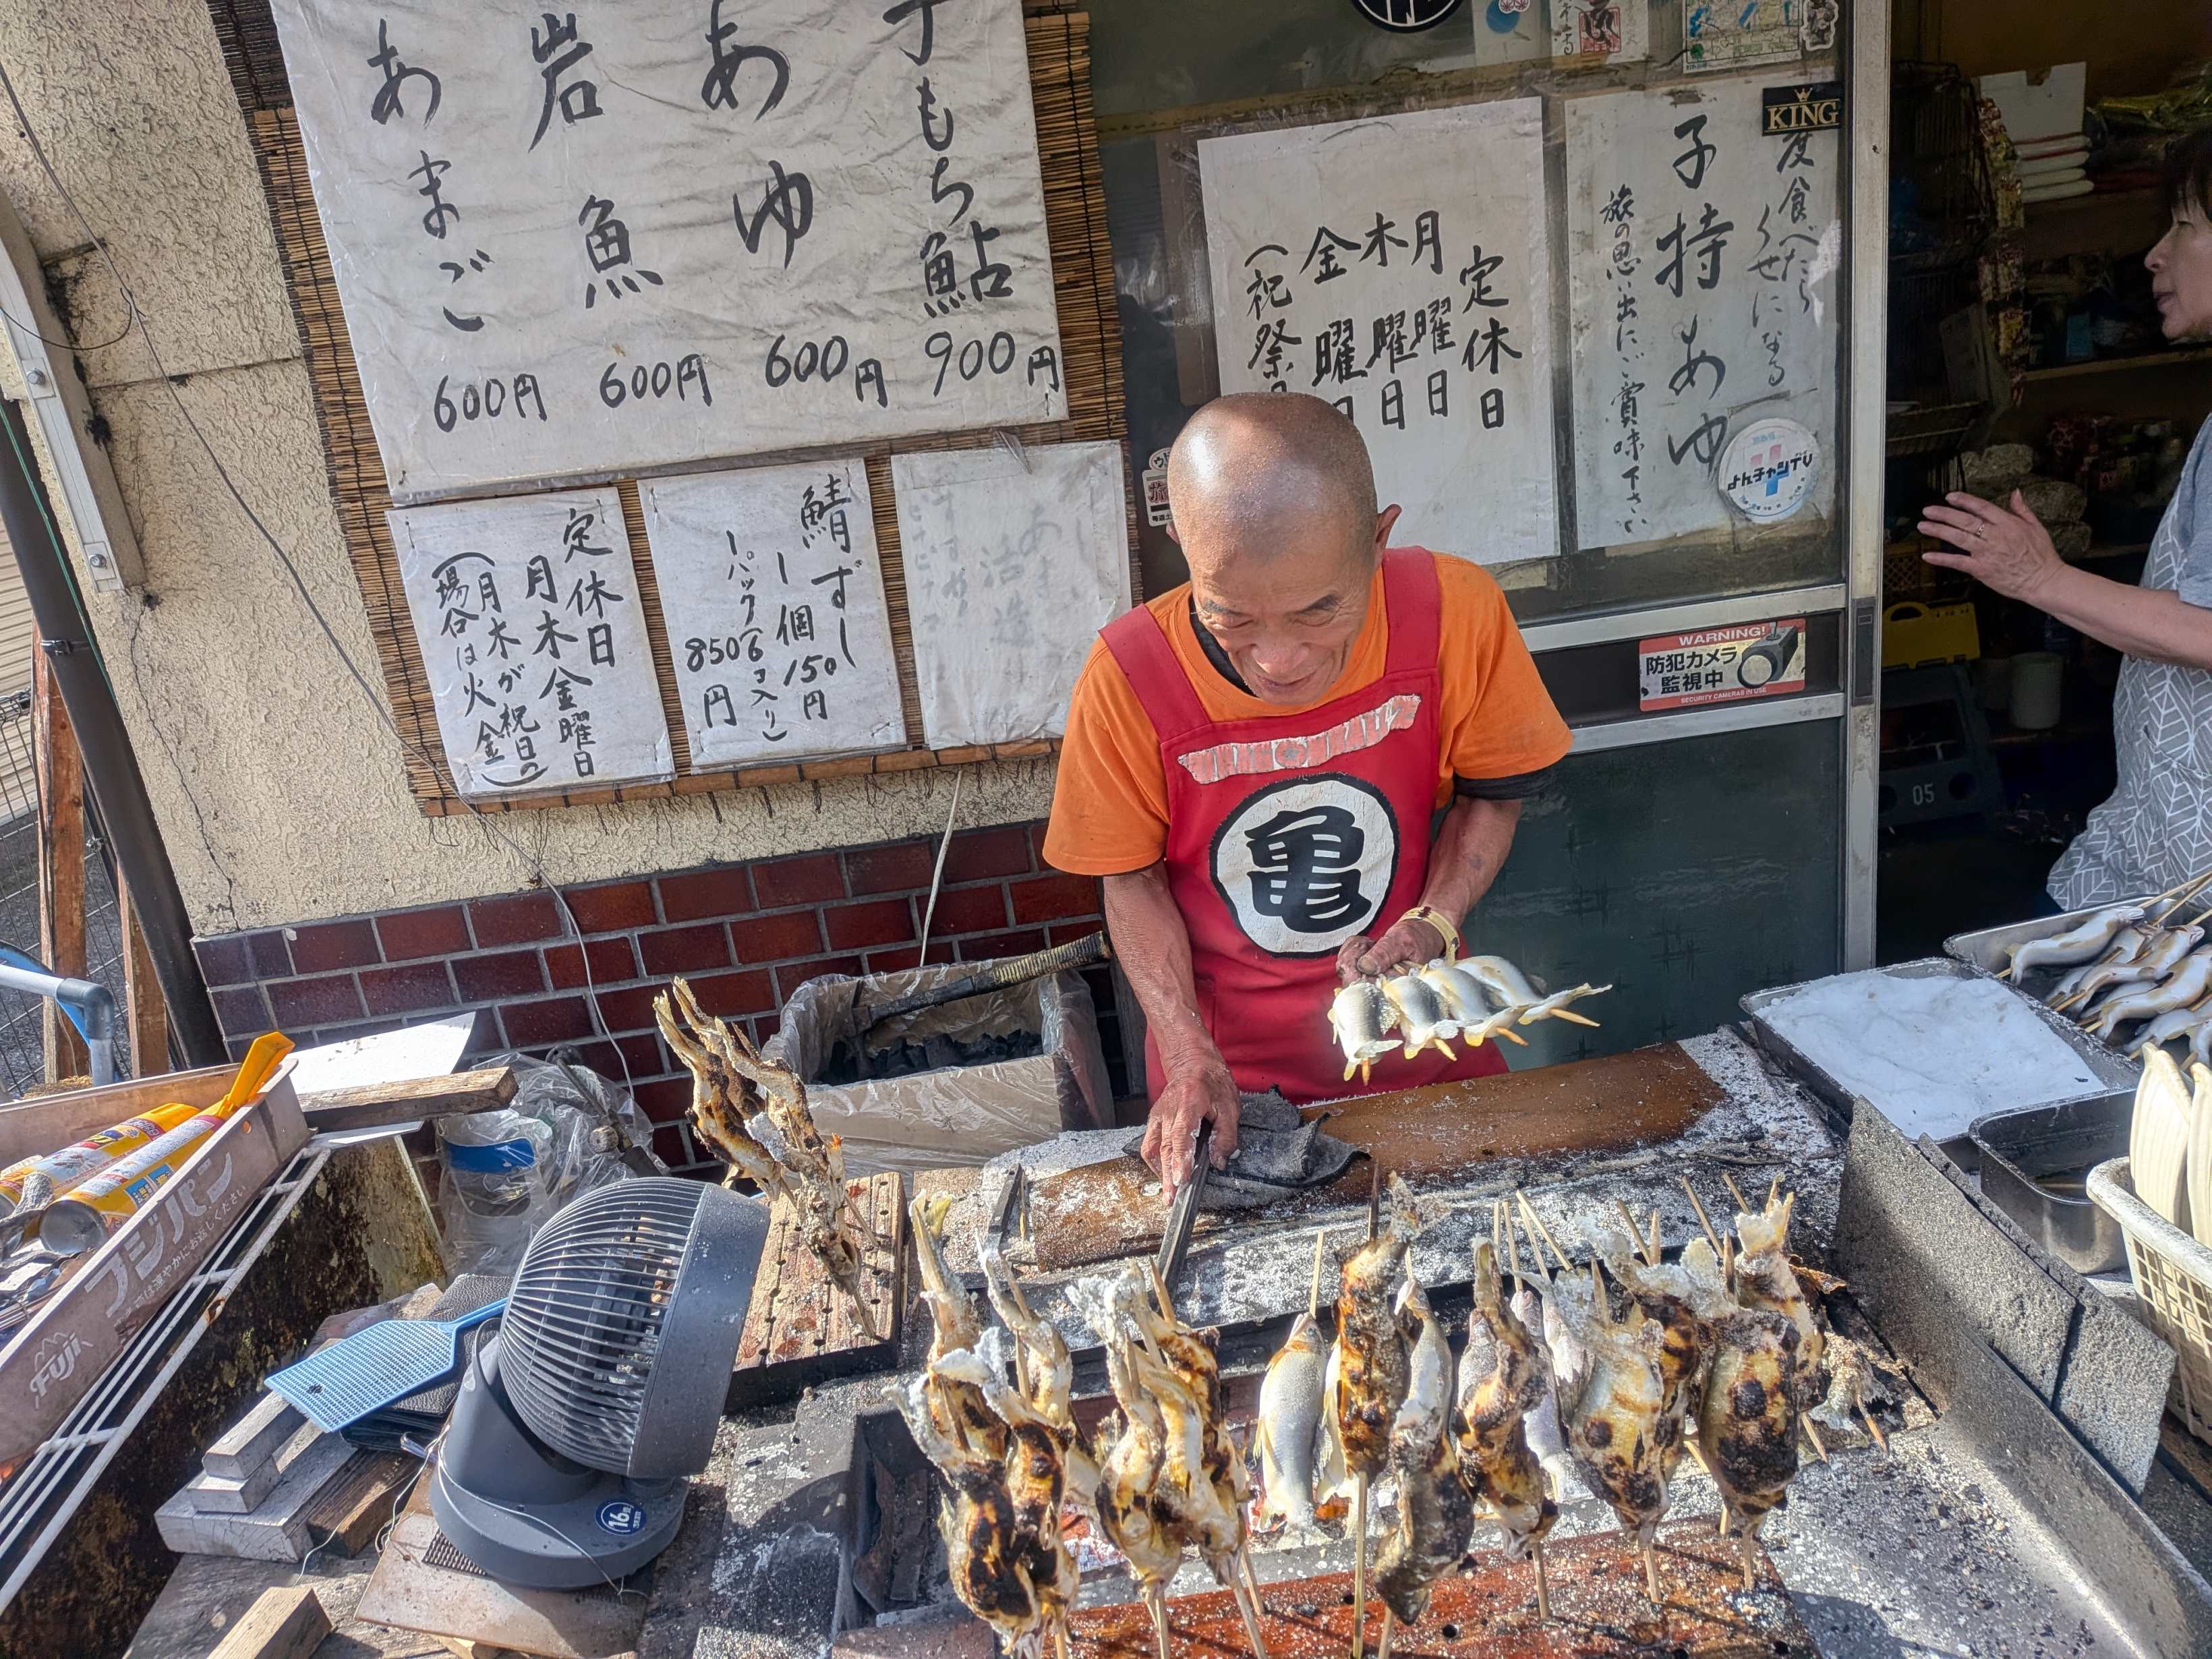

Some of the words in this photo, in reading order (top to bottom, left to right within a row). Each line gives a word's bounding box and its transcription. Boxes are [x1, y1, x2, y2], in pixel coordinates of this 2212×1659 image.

[367, 18, 494, 332] あまご
[528, 13, 664, 308] 岩魚
[701, 0, 813, 269] あゆ
[1767, 102, 1838, 130] KING
[925, 330, 1059, 397] 900円
[1360, 212, 1418, 430] 木曜日
[1411, 210, 1455, 417] 月曜日
[1459, 245, 1522, 430] 定休日
[1655, 114, 1728, 480] 子持あゆ
[434, 374, 547, 432] 600円
[600, 353, 712, 408] 600円
[765, 334, 887, 408] 600円
[562, 508, 624, 668] 定休日
[801, 474, 863, 668] 鯖ずし
[1679, 626, 1766, 646] WARNING!
[525, 555, 596, 778] 月木金曜日
[1646, 646, 1737, 676] 防犯カメラ
[1661, 670, 1724, 695] 監視中
[1681, 695, 1712, 704] SECURITY
[1713, 691, 1745, 700] CAMERAS
[1913, 783, 1936, 806] 05
[1244, 806, 1372, 933] 亀
[84, 1152, 233, 1318] フジパン
